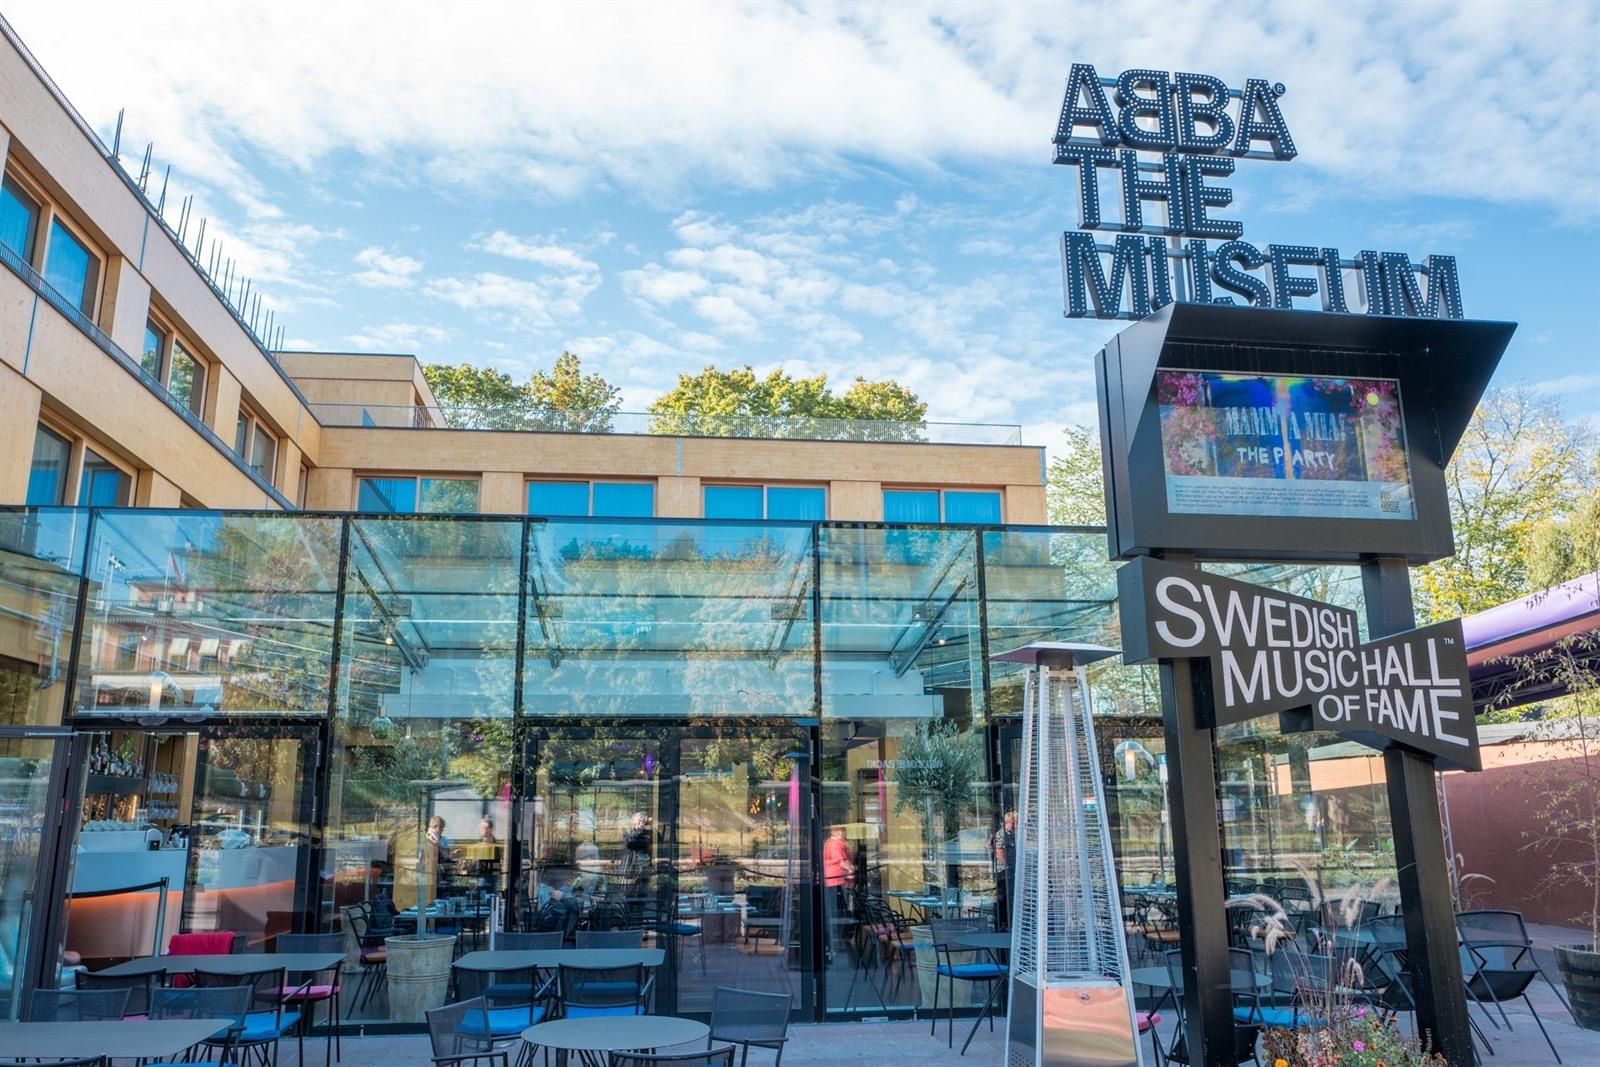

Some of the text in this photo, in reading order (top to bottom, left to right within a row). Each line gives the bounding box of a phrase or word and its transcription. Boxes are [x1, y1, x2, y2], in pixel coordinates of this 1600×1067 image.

[1053, 144, 1243, 239] THE
[1061, 231, 1464, 320] MUSEUM
[1236, 446, 1335, 470] THE PARTY
[1155, 576, 1354, 648] SWEDISH
[1221, 650, 1358, 707] MUSIC
[1360, 638, 1460, 686] HALL
[1318, 689, 1469, 746] OF FAME
